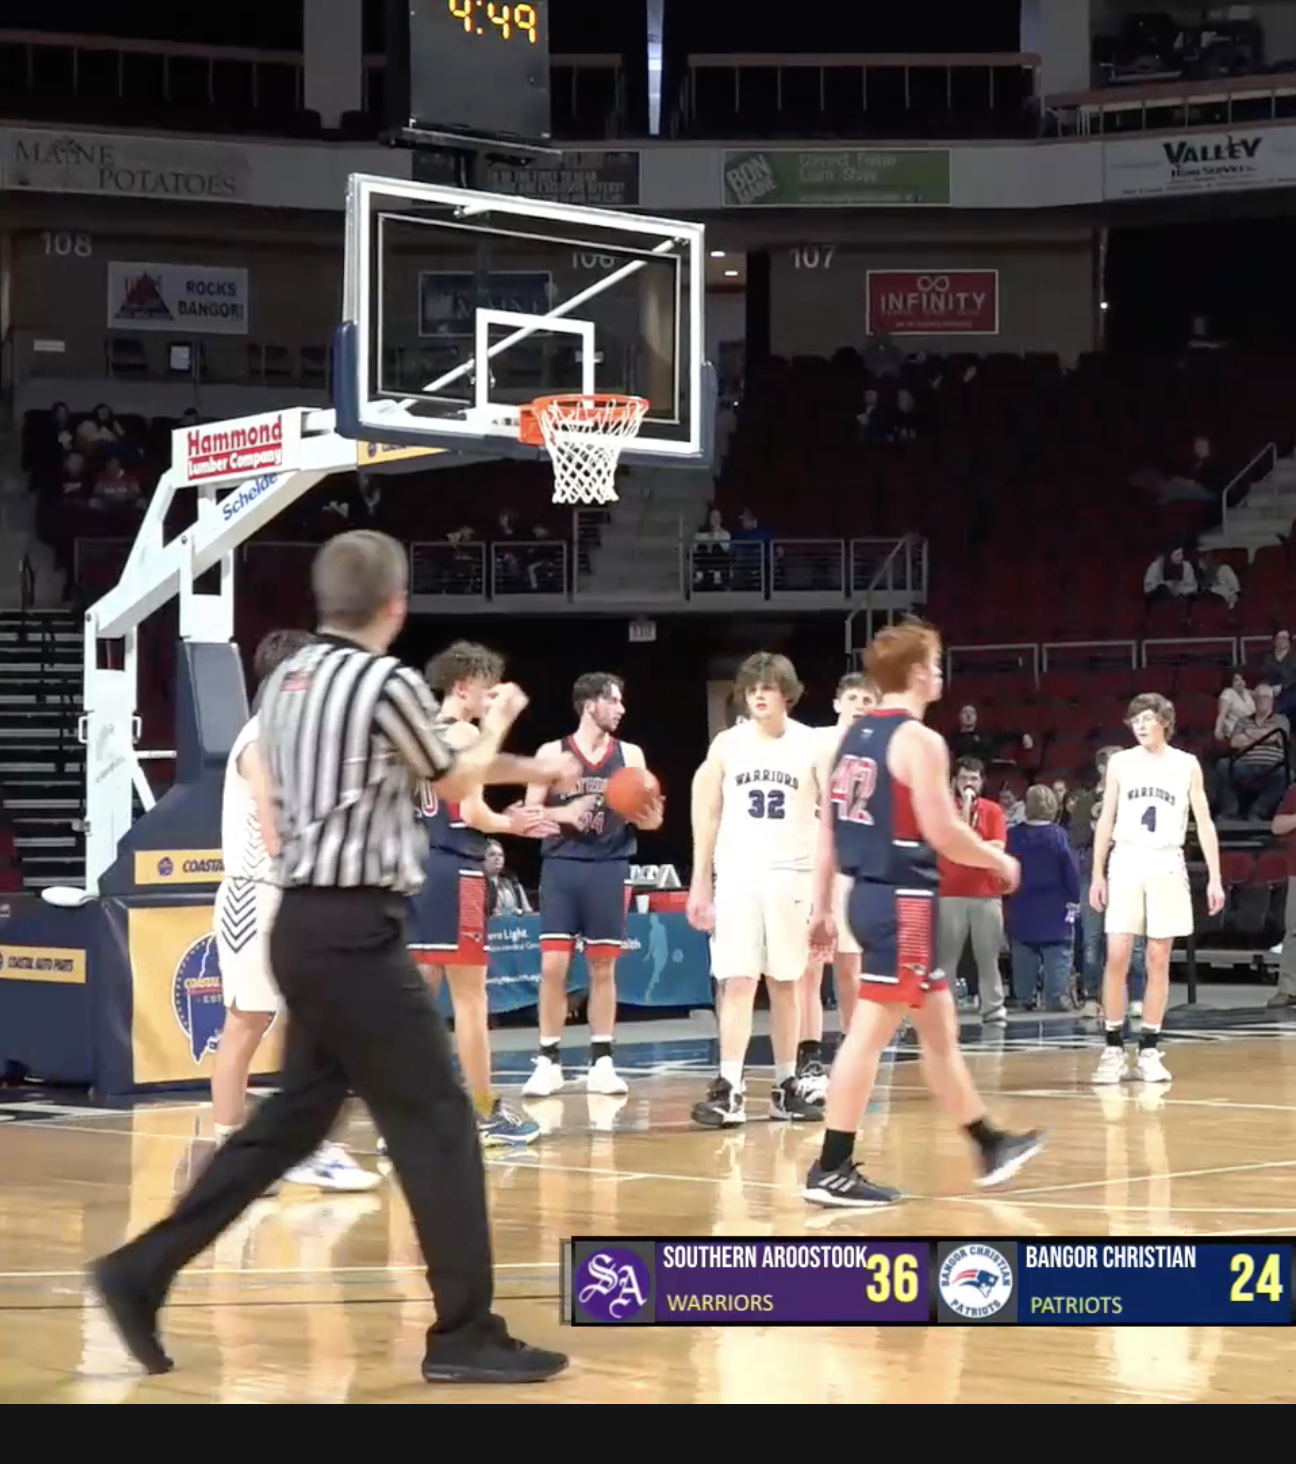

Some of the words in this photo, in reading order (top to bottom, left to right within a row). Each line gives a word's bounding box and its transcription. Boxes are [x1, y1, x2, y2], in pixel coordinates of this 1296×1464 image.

[448, 0, 536, 43] 4:49
[16, 139, 116, 166] MAINE
[1162, 136, 1263, 164] VALLEY
[100, 168, 236, 196] POTATOES
[726, 154, 771, 192] BDN
[41, 232, 92, 257] 108
[790, 244, 837, 269] 107
[186, 280, 236, 297] ROCKS
[880, 291, 986, 312] INFINITY
[187, 414, 283, 456] Hammond
[188, 455, 227, 477] Lumber
[229, 446, 283, 470] Company
[222, 473, 278, 521] Schelde
[735, 769, 799, 790] WARRIORS
[748, 789, 785, 819] 32
[1141, 805, 1157, 833] 4
[183, 859, 225, 873] COASTA
